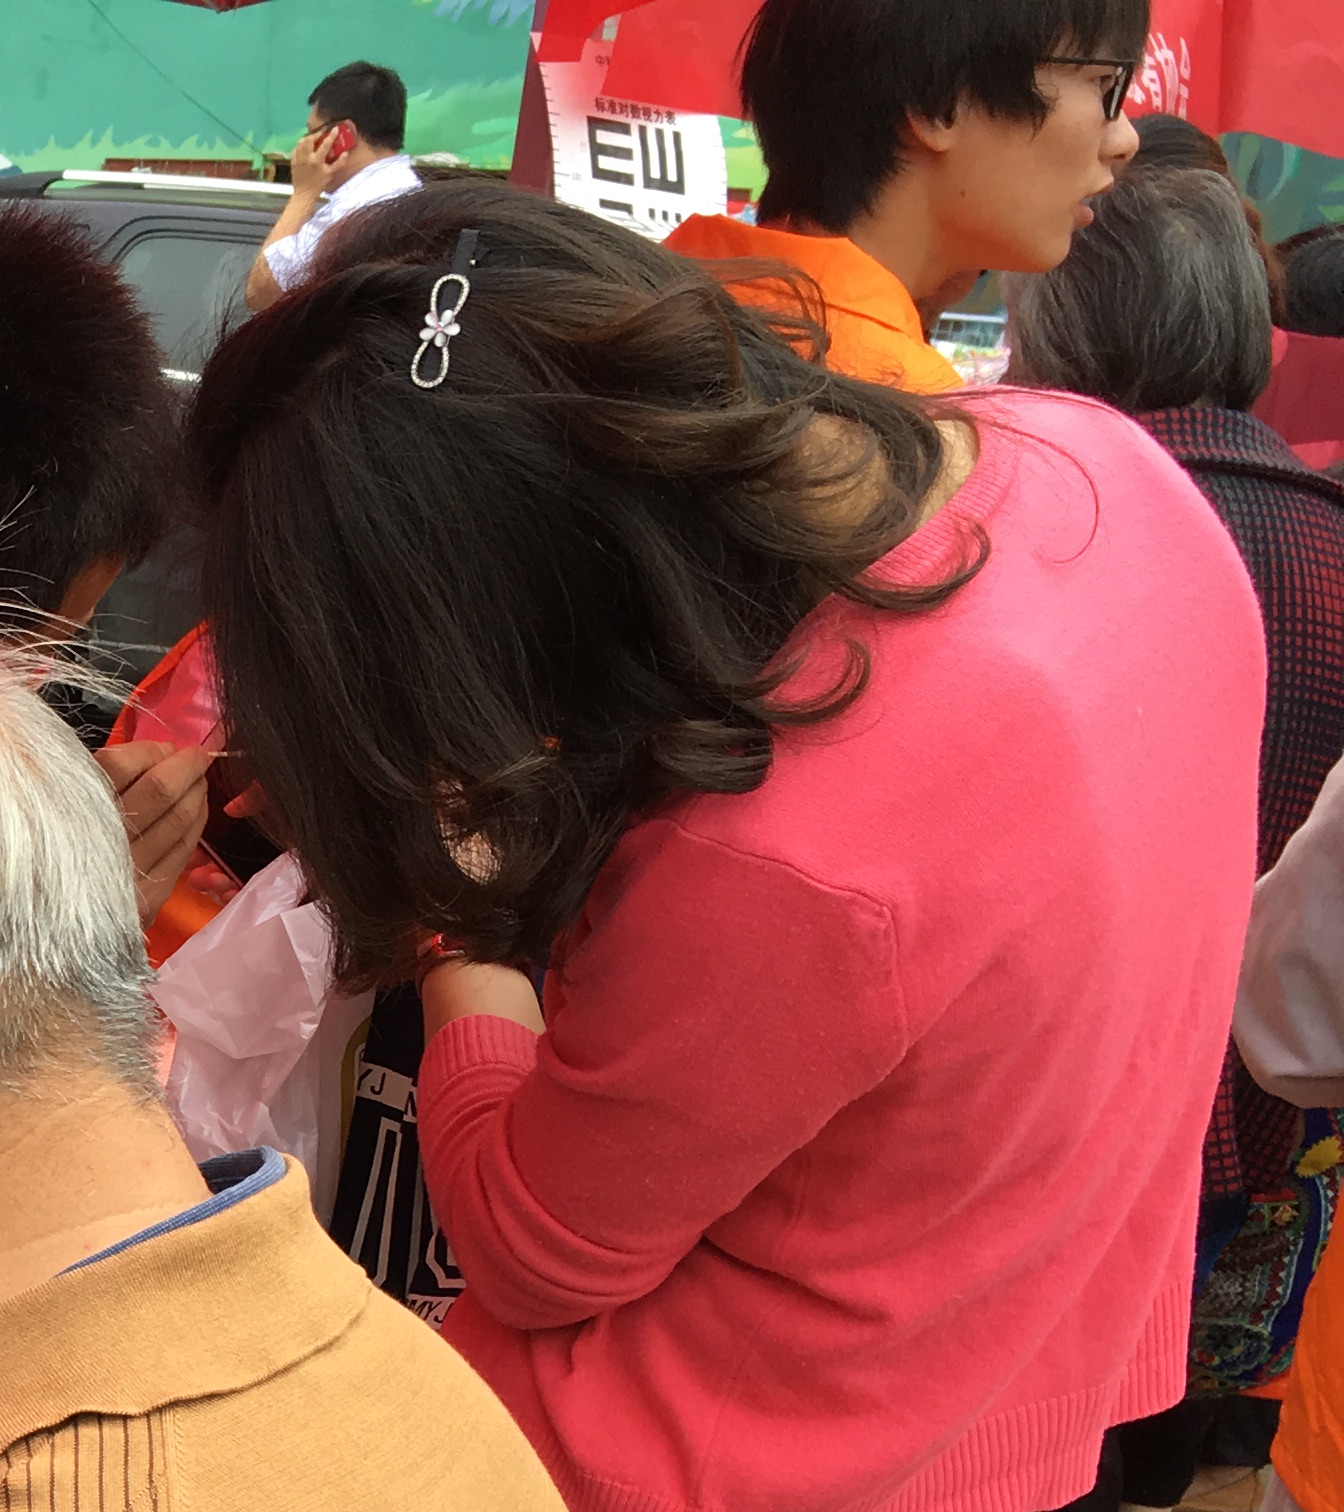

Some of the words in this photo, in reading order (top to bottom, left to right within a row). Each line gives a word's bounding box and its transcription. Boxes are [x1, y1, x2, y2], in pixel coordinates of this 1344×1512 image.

[594, 96, 676, 126] 标准对数视力表
